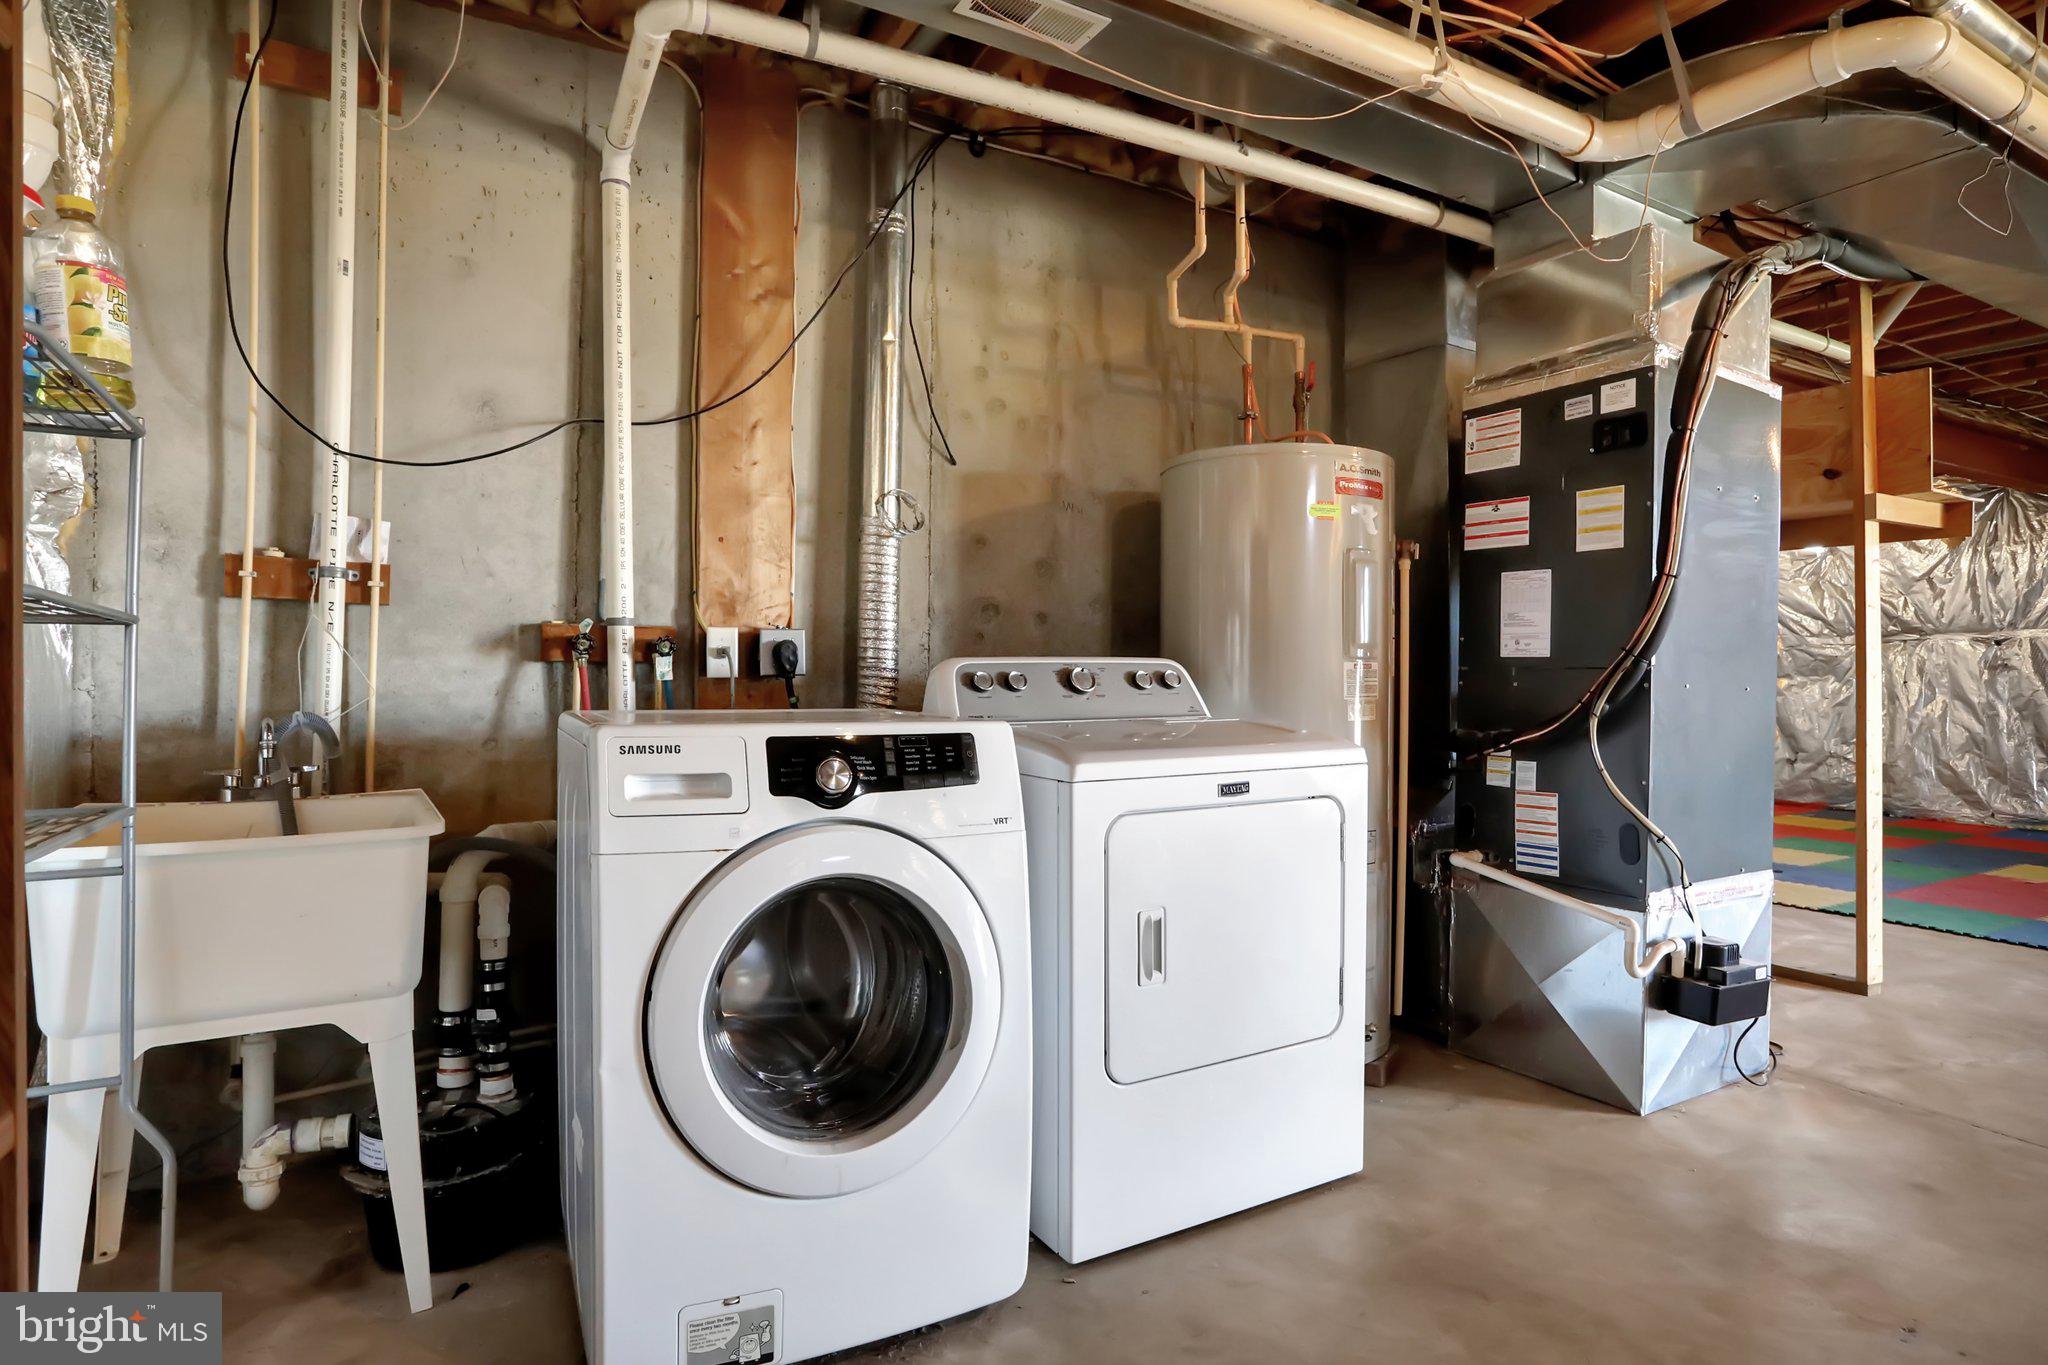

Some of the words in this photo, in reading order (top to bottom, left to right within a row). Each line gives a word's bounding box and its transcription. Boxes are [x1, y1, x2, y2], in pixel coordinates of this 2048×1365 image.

[619, 744, 681, 755] SAMSUNG
[1222, 783, 1249, 794] MAYTAG
[993, 817, 1009, 825] VRT
